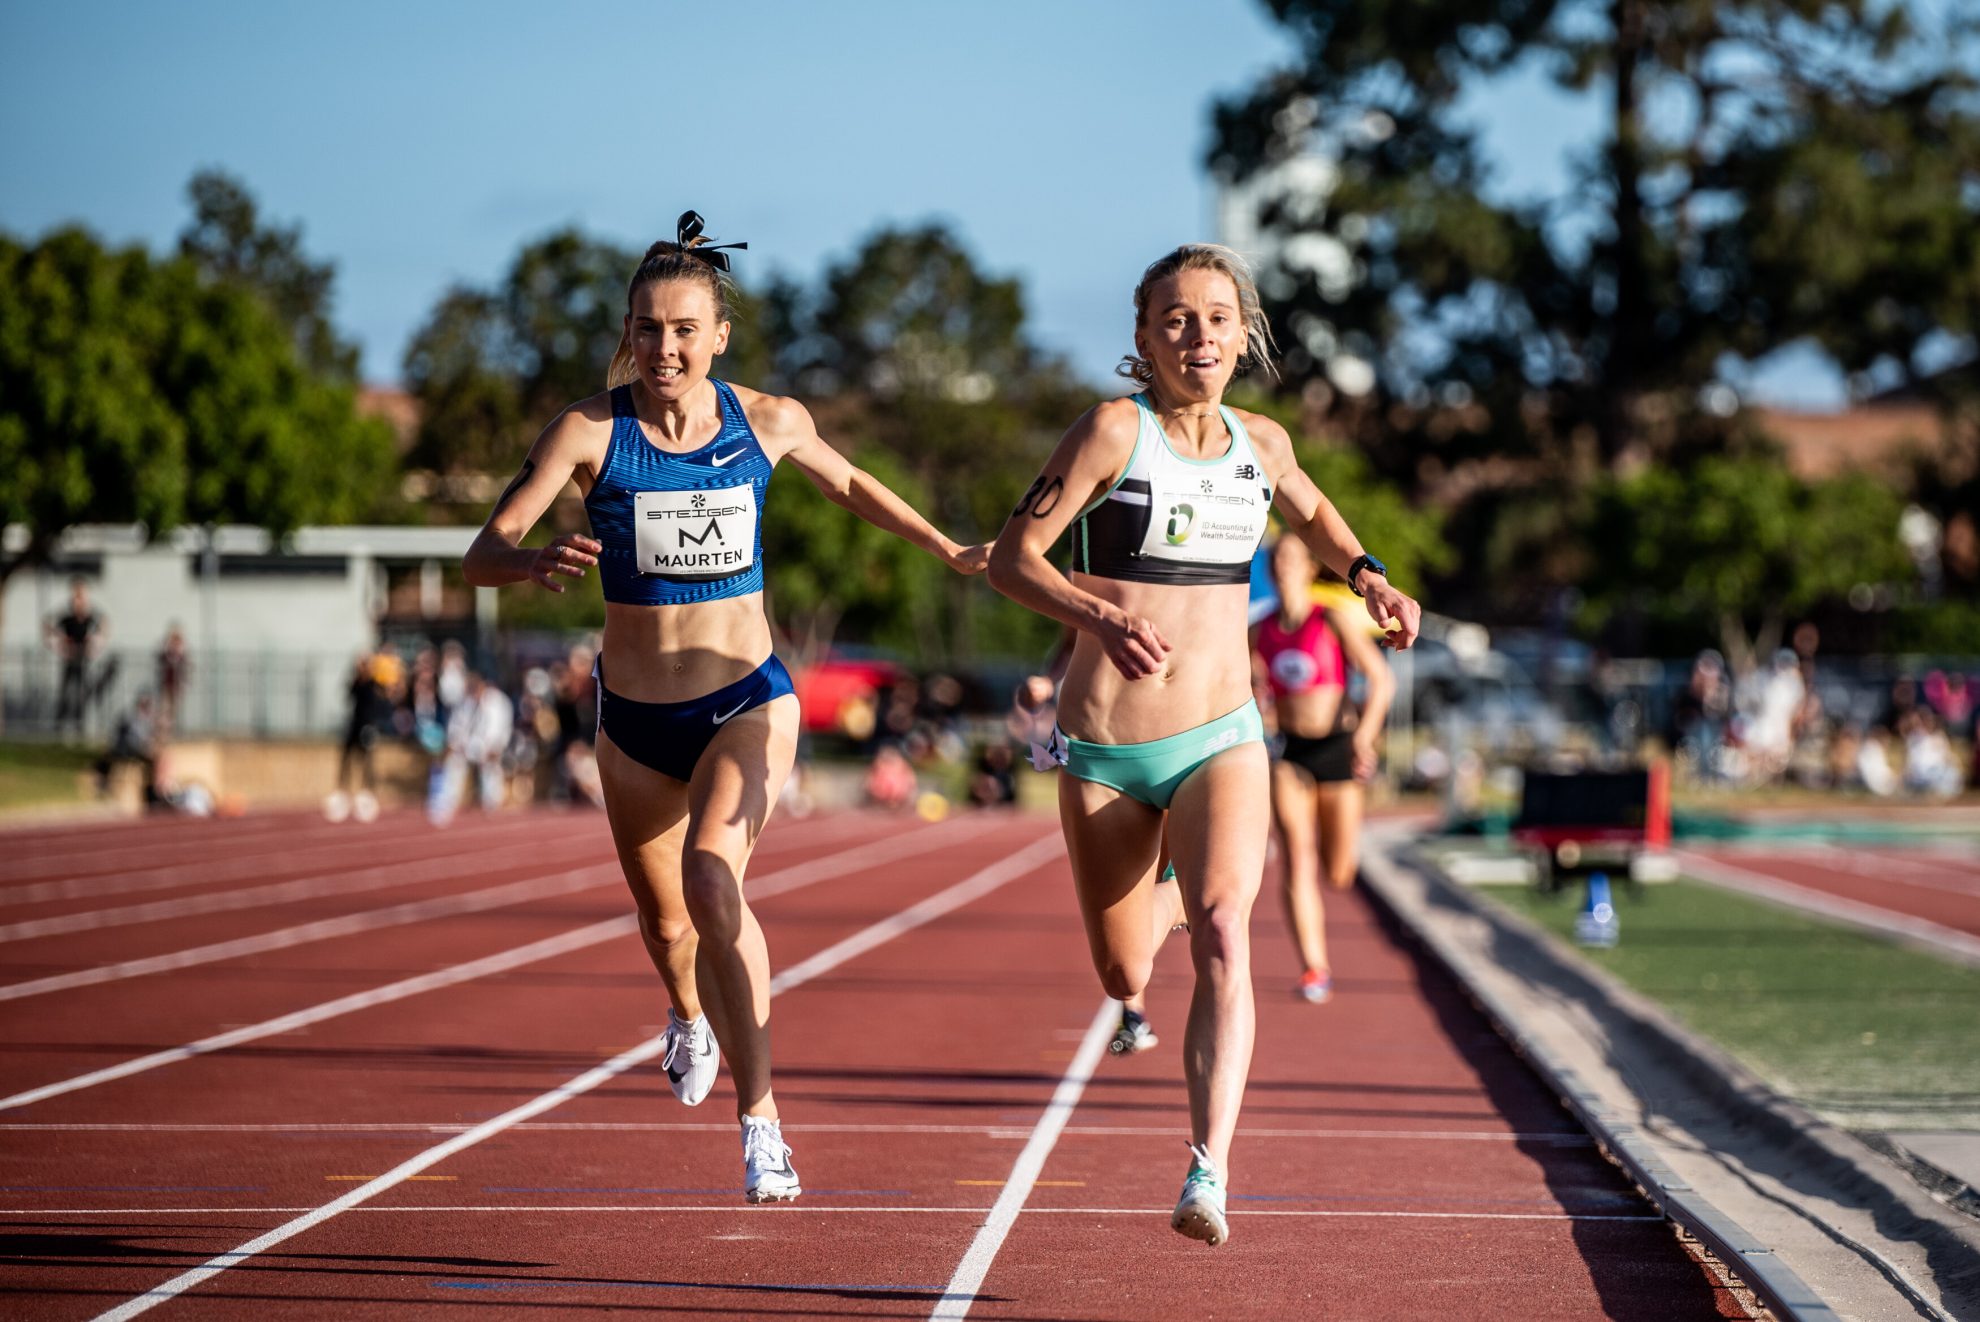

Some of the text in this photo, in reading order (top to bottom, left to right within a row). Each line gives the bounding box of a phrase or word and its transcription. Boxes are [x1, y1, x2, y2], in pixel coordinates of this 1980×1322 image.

[646, 504, 747, 520] STEIGEN
[1211, 522, 1248, 534] Accounting
[1249, 523, 1254, 532] &
[1200, 531, 1255, 542] Wealth Solutions
[655, 548, 743, 567] MAURTEN
